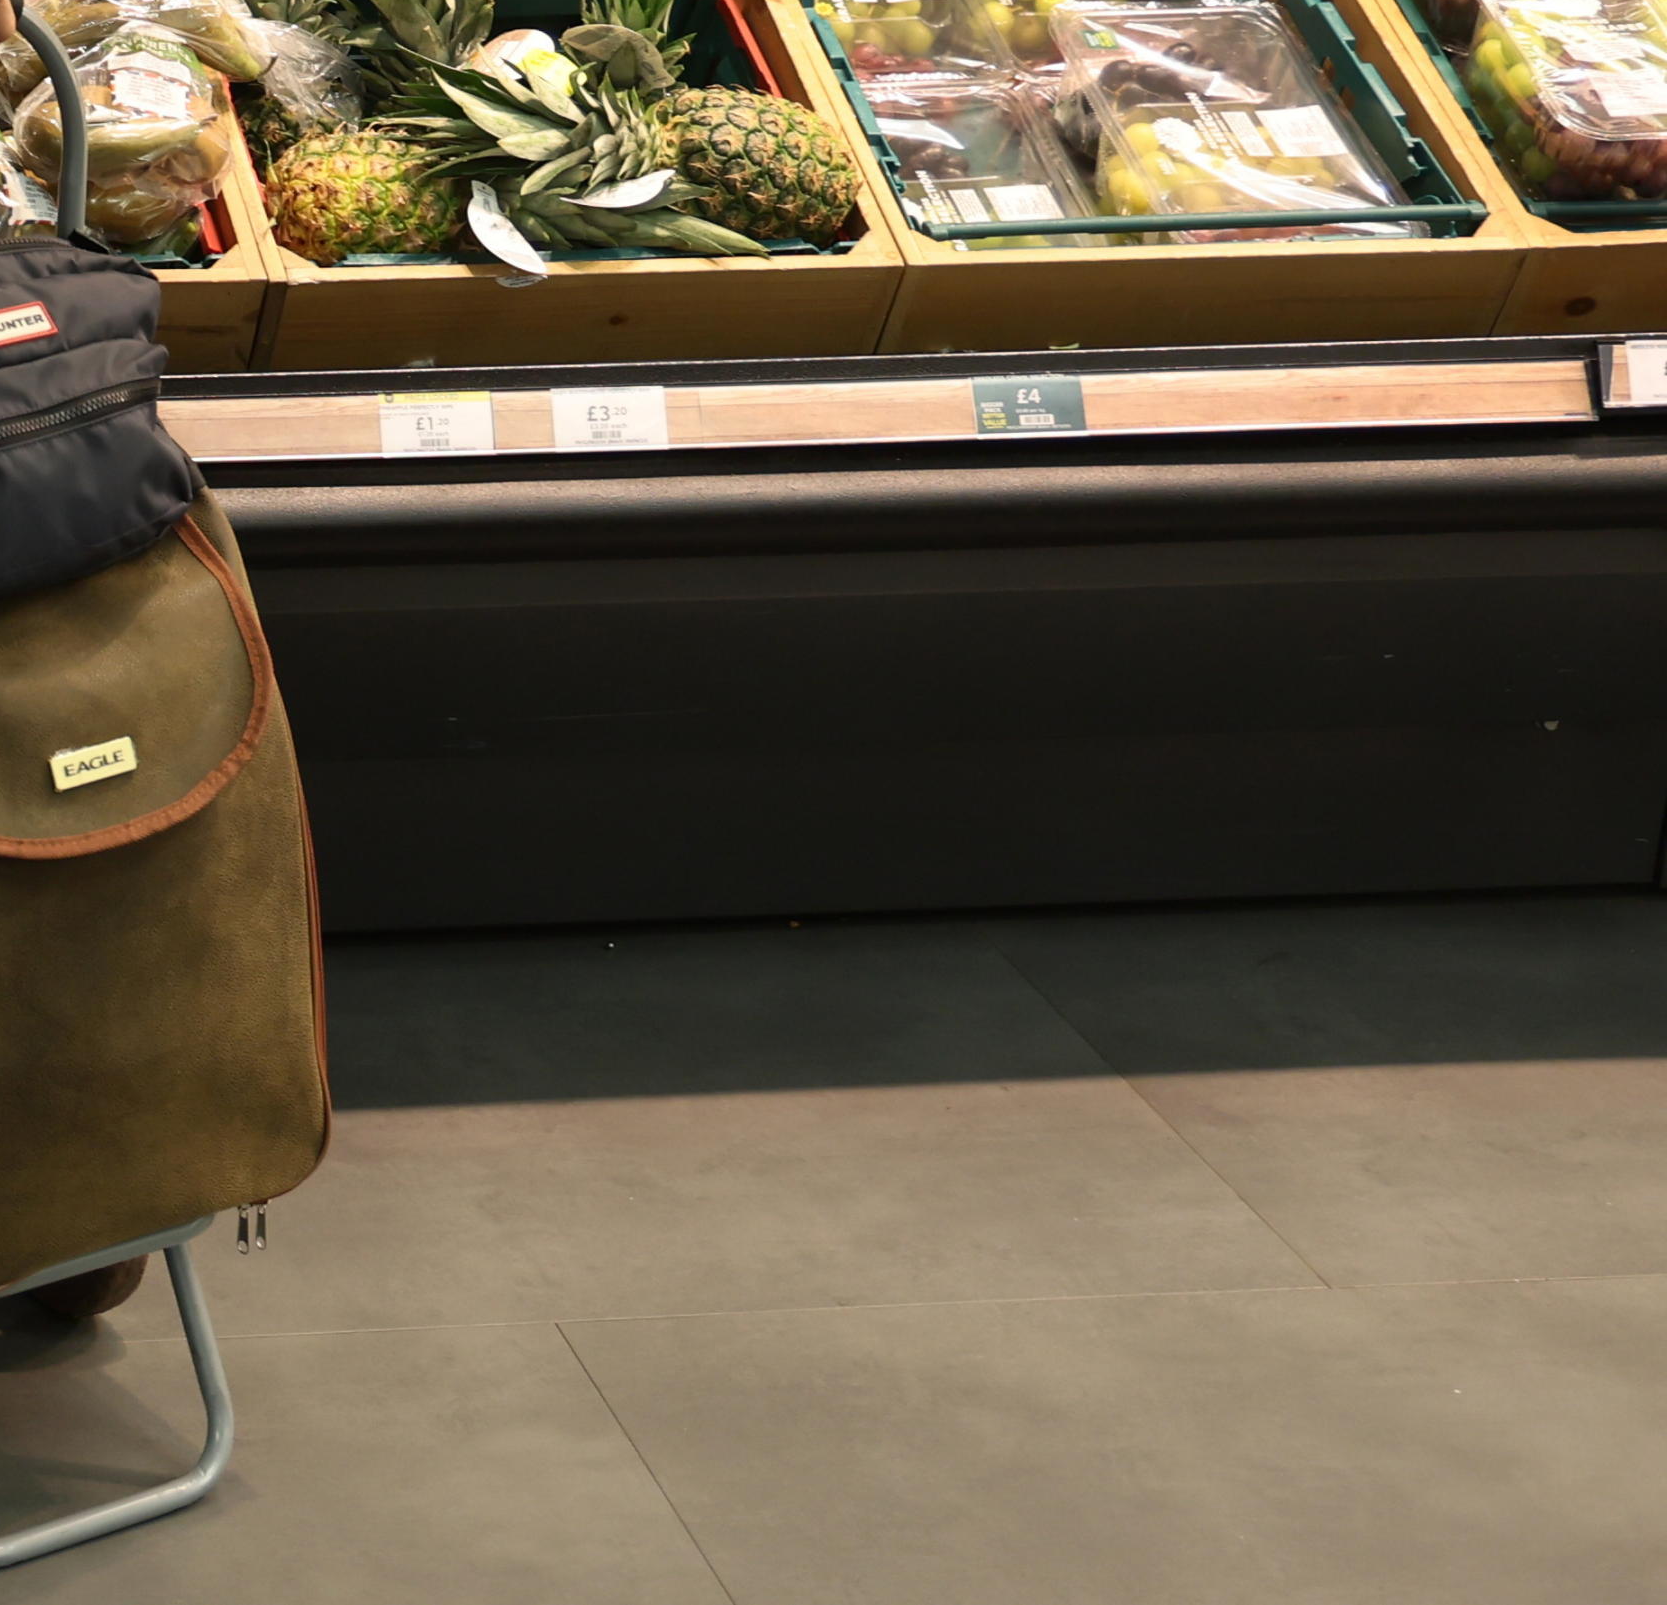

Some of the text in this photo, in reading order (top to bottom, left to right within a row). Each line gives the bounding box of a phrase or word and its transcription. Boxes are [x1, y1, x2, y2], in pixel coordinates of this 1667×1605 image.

[1016, 387, 1042, 405] £4
[587, 405, 628, 423] £3.20
[416, 416, 450, 431] £1.20
[63, 748, 126, 779] EAGLE
